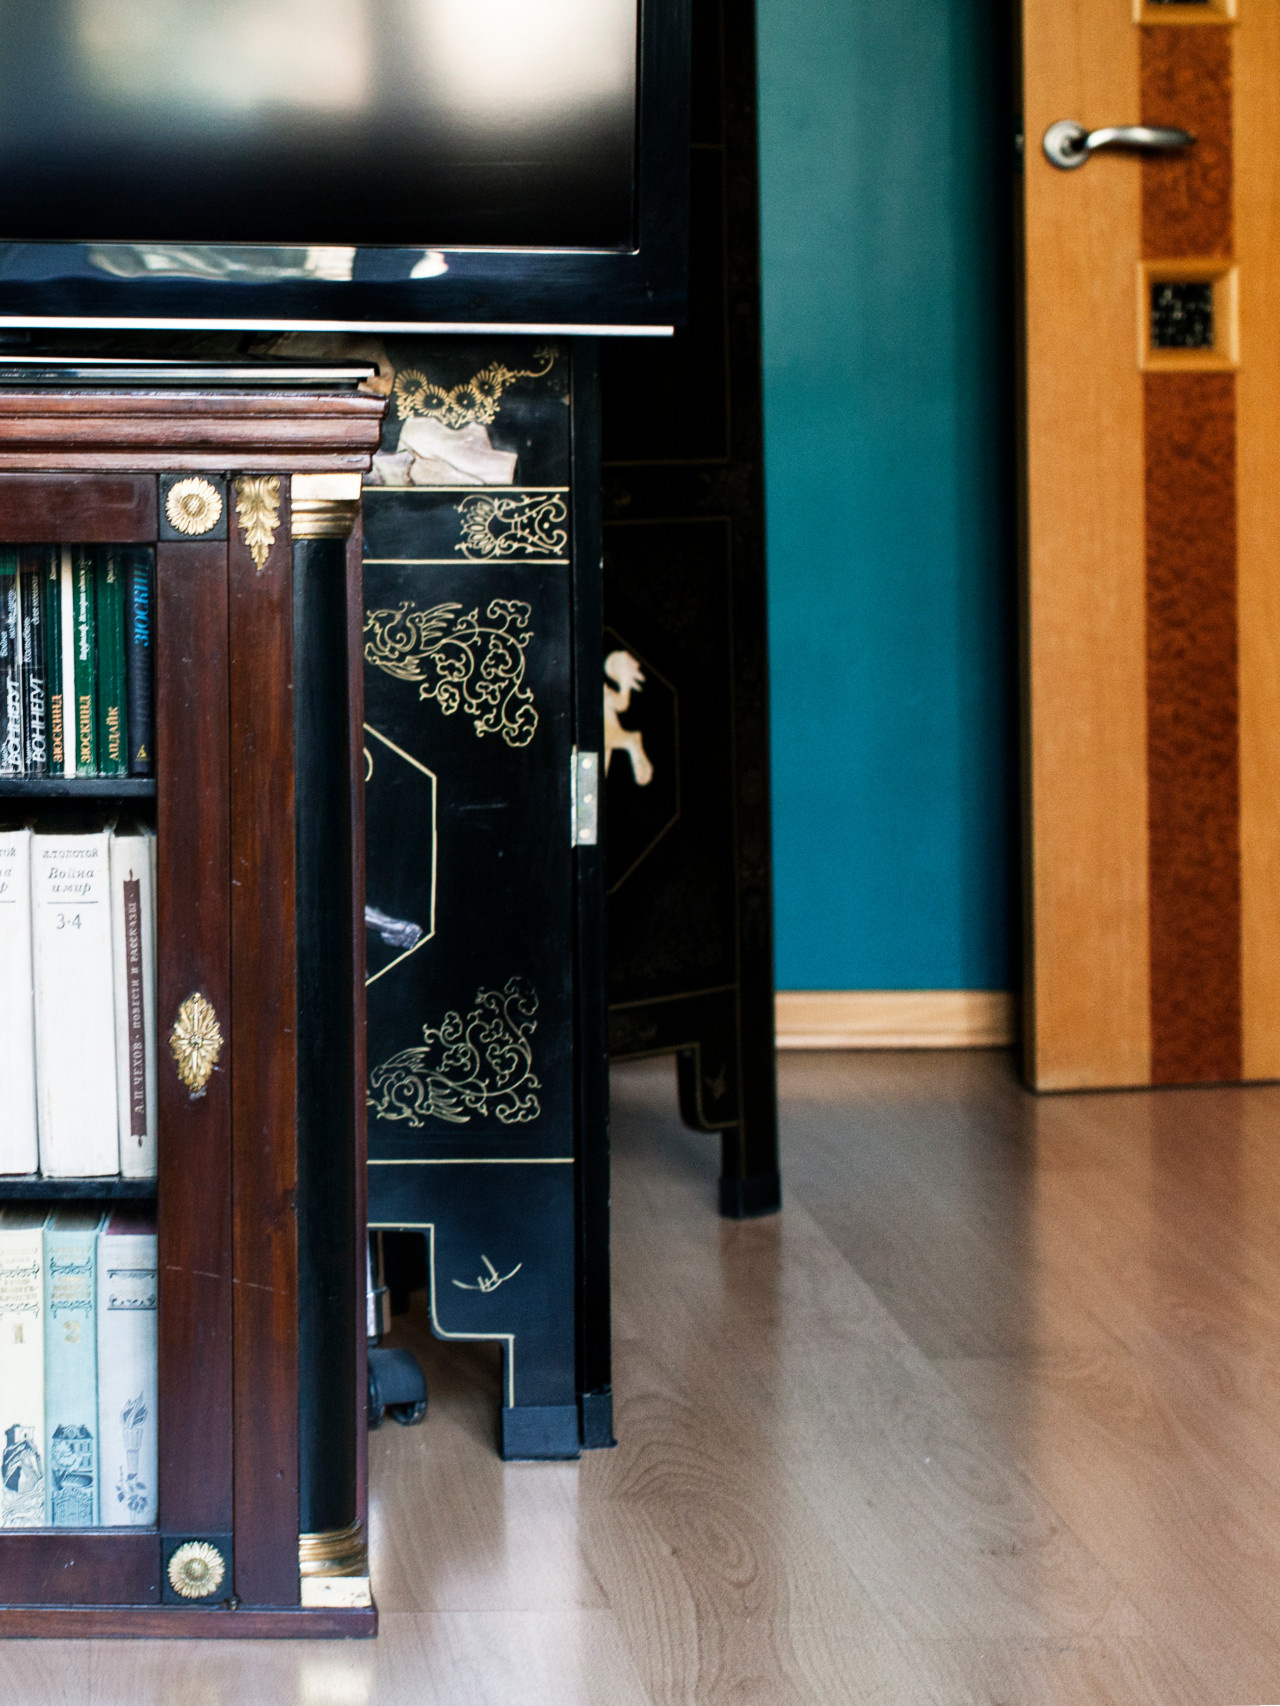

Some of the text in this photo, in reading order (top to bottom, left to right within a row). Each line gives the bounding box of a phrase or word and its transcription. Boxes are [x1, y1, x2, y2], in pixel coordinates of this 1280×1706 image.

[6, 677, 22, 769] ВОННЕГУТ
[29, 674, 47, 763] ВОННЕГУТ
[52, 694, 64, 763] ЗЮСКИНД
[80, 694, 92, 763] ЗЮСКИНД
[105, 706, 120, 760] АПДАЙК
[48, 867, 95, 879] Война
[62, 883, 91, 895] мир
[129, 902, 140, 962] РАССКАЗЫ
[131, 978, 142, 1030] ПОВЕСТИ
[63, 1321, 81, 1343] 2
